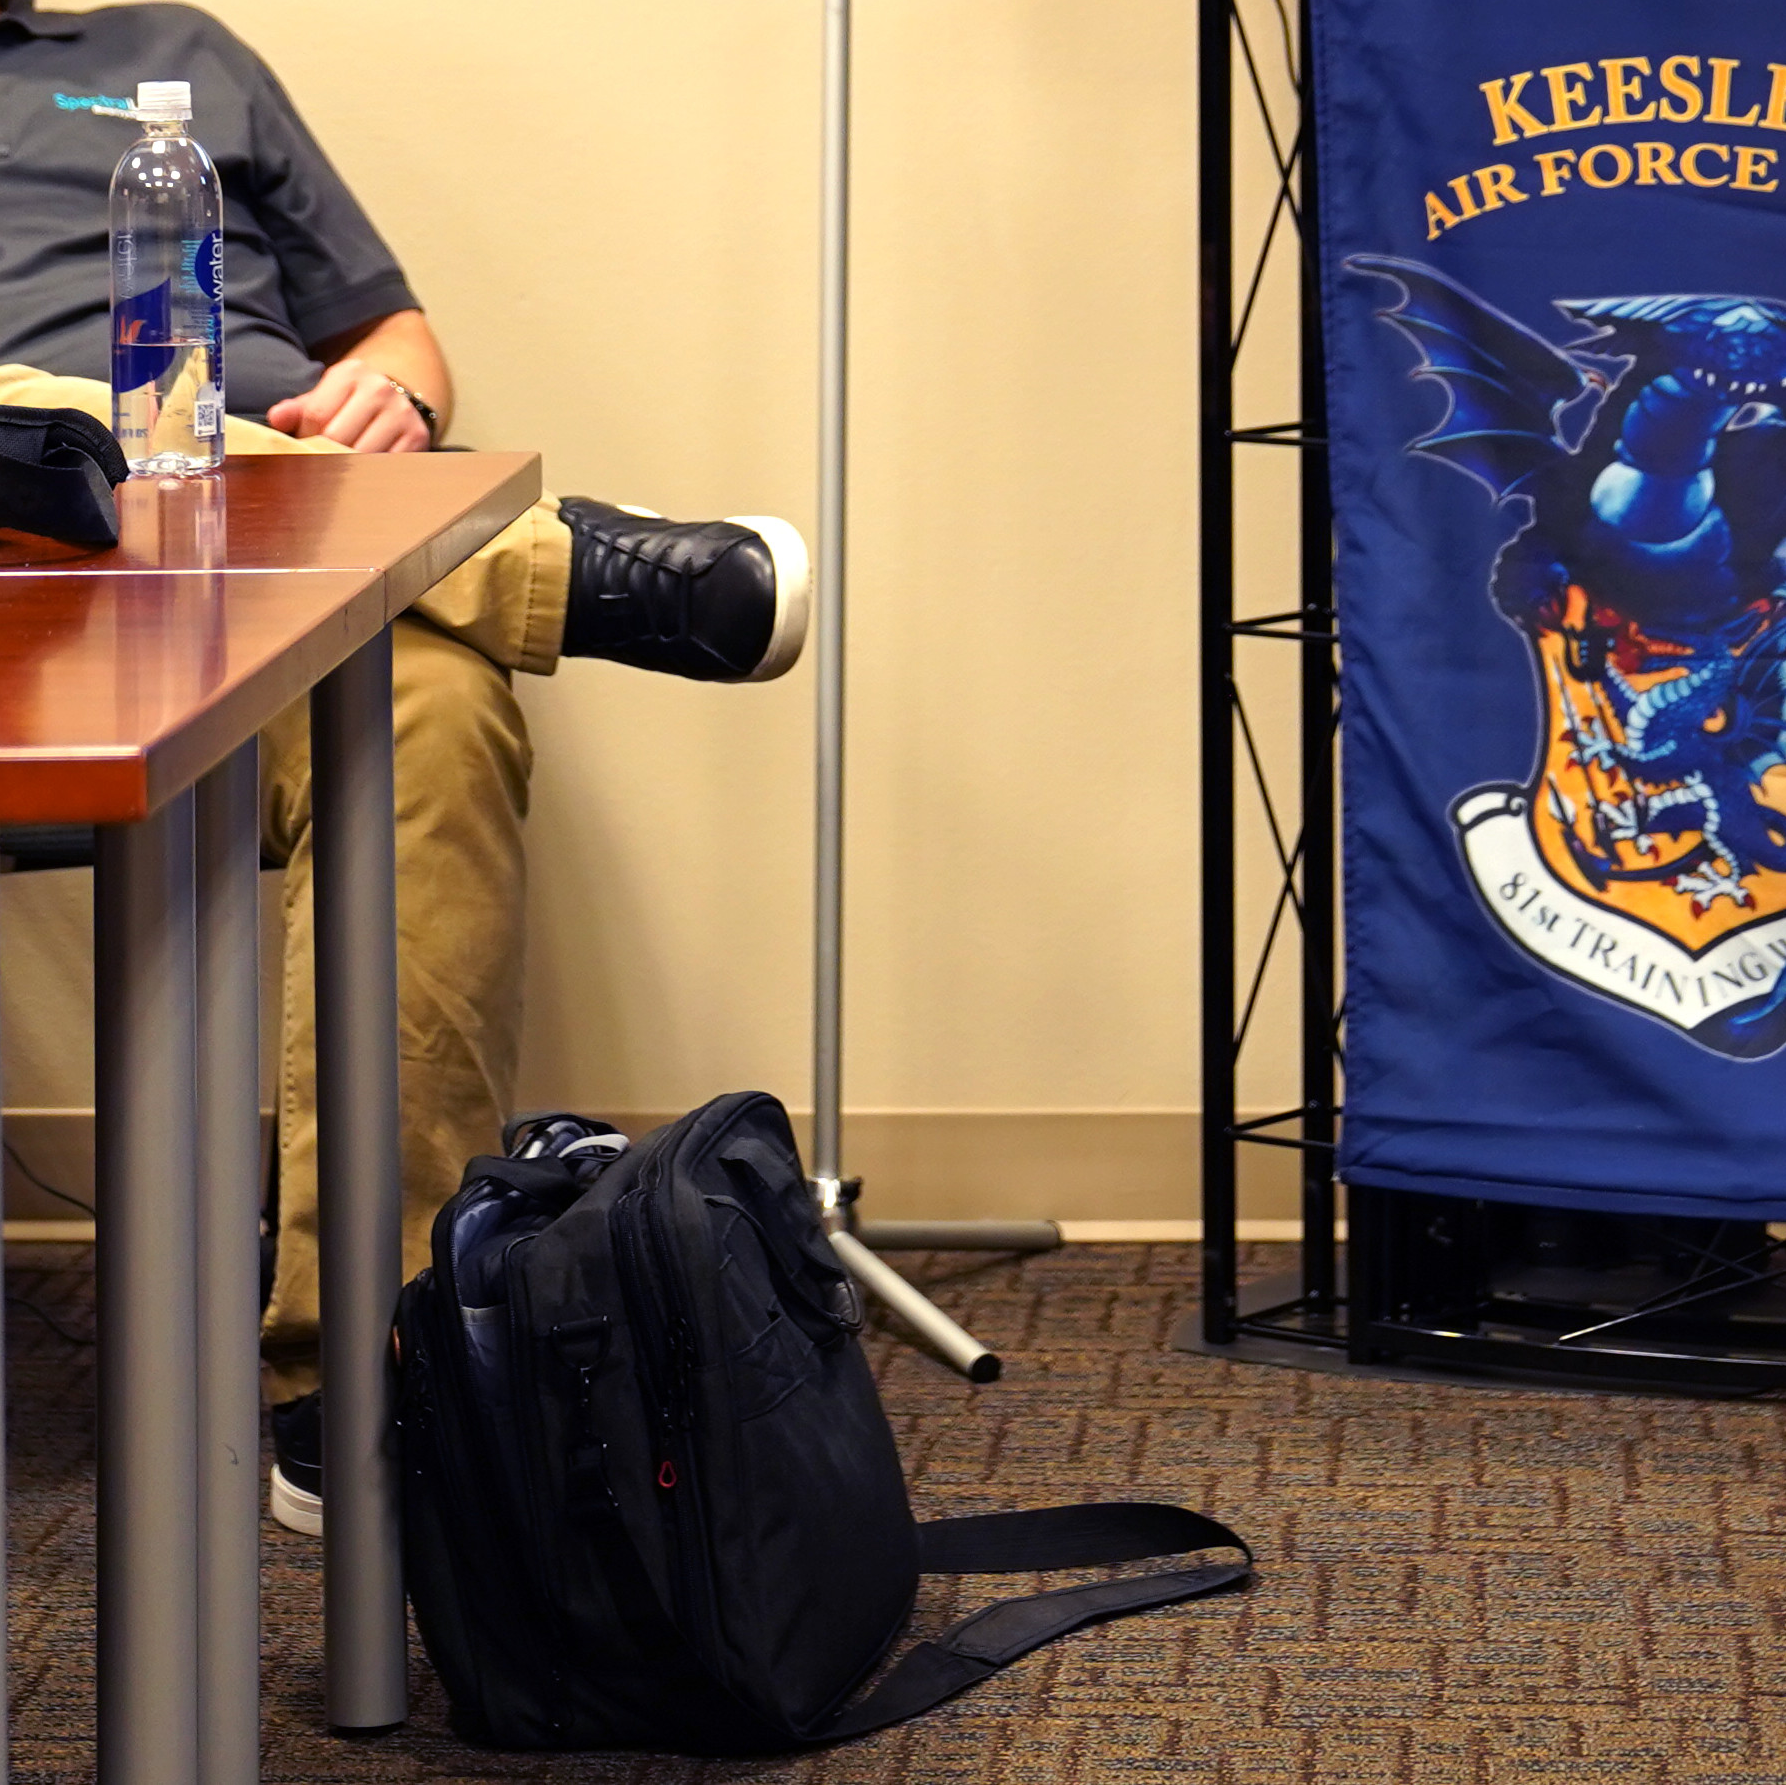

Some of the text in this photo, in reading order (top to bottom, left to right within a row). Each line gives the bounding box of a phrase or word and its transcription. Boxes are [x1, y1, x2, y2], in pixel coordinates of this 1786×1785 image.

[1423, 163, 1529, 241] AIR
[1533, 141, 1780, 198] FORCE
[1499, 872, 1558, 935] 81st
[1568, 917, 1769, 1008] TRAINING
